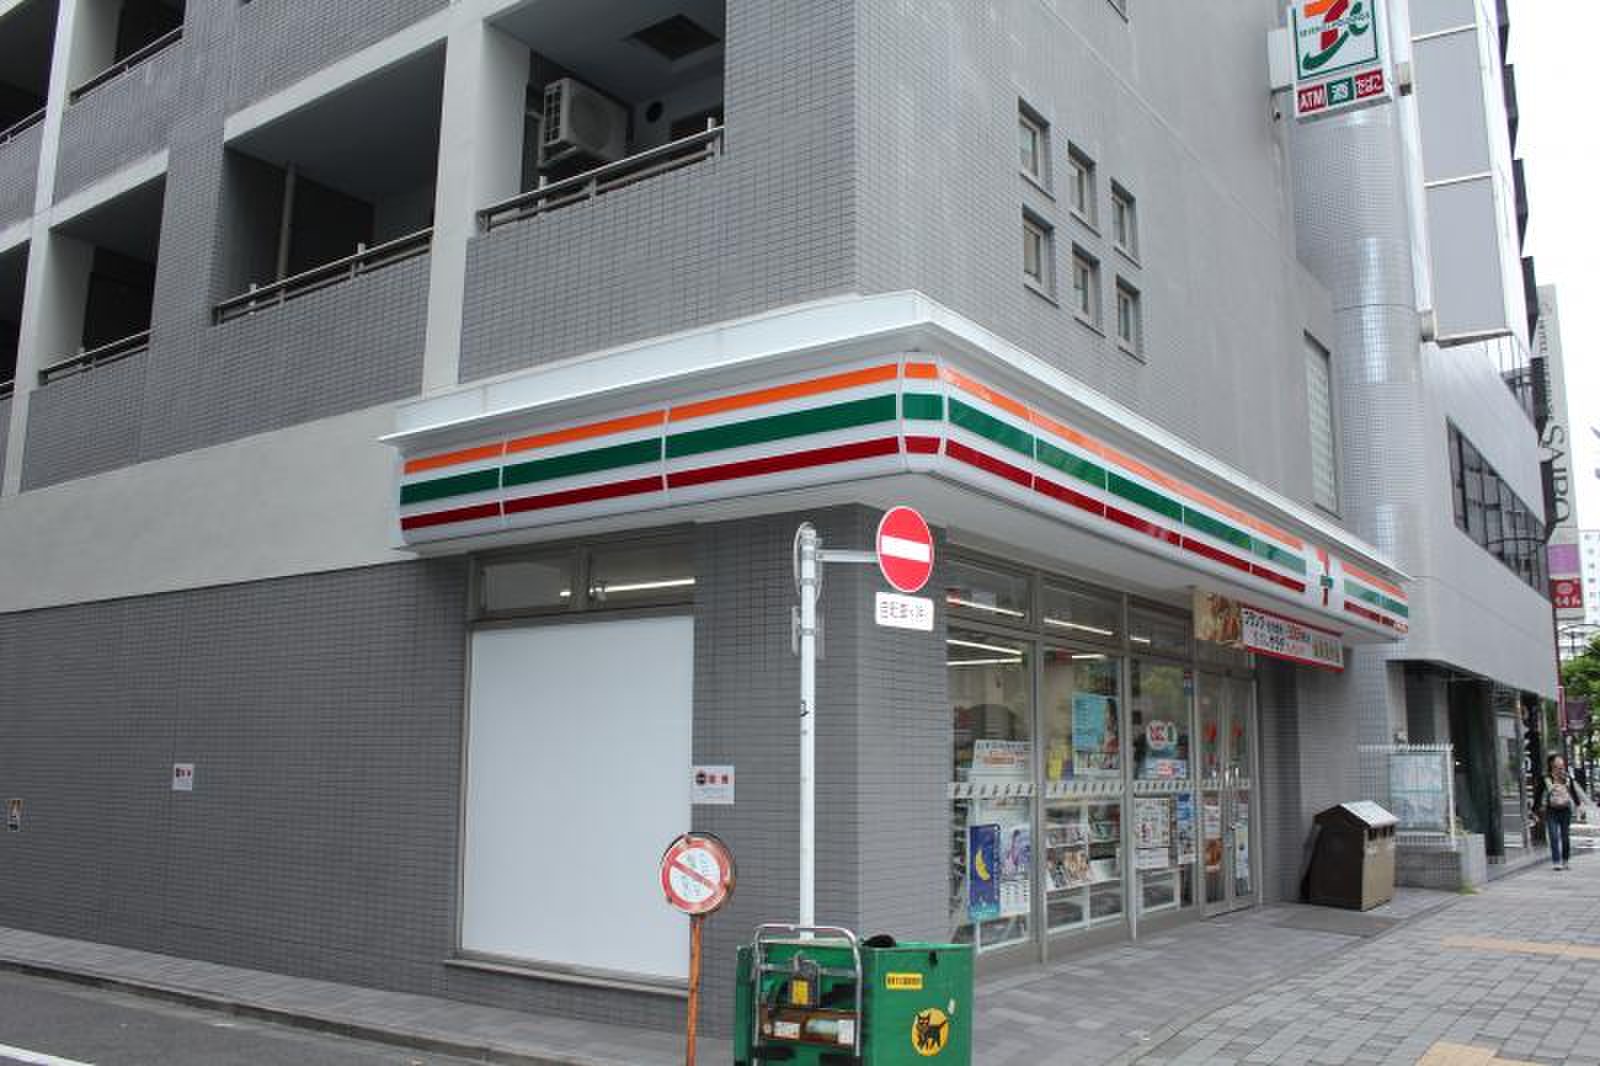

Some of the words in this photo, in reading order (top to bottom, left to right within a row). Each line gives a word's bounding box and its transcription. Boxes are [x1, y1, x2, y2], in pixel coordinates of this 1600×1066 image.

[1300, 88, 1324, 109] ATM
[1355, 74, 1382, 95] たばこ
